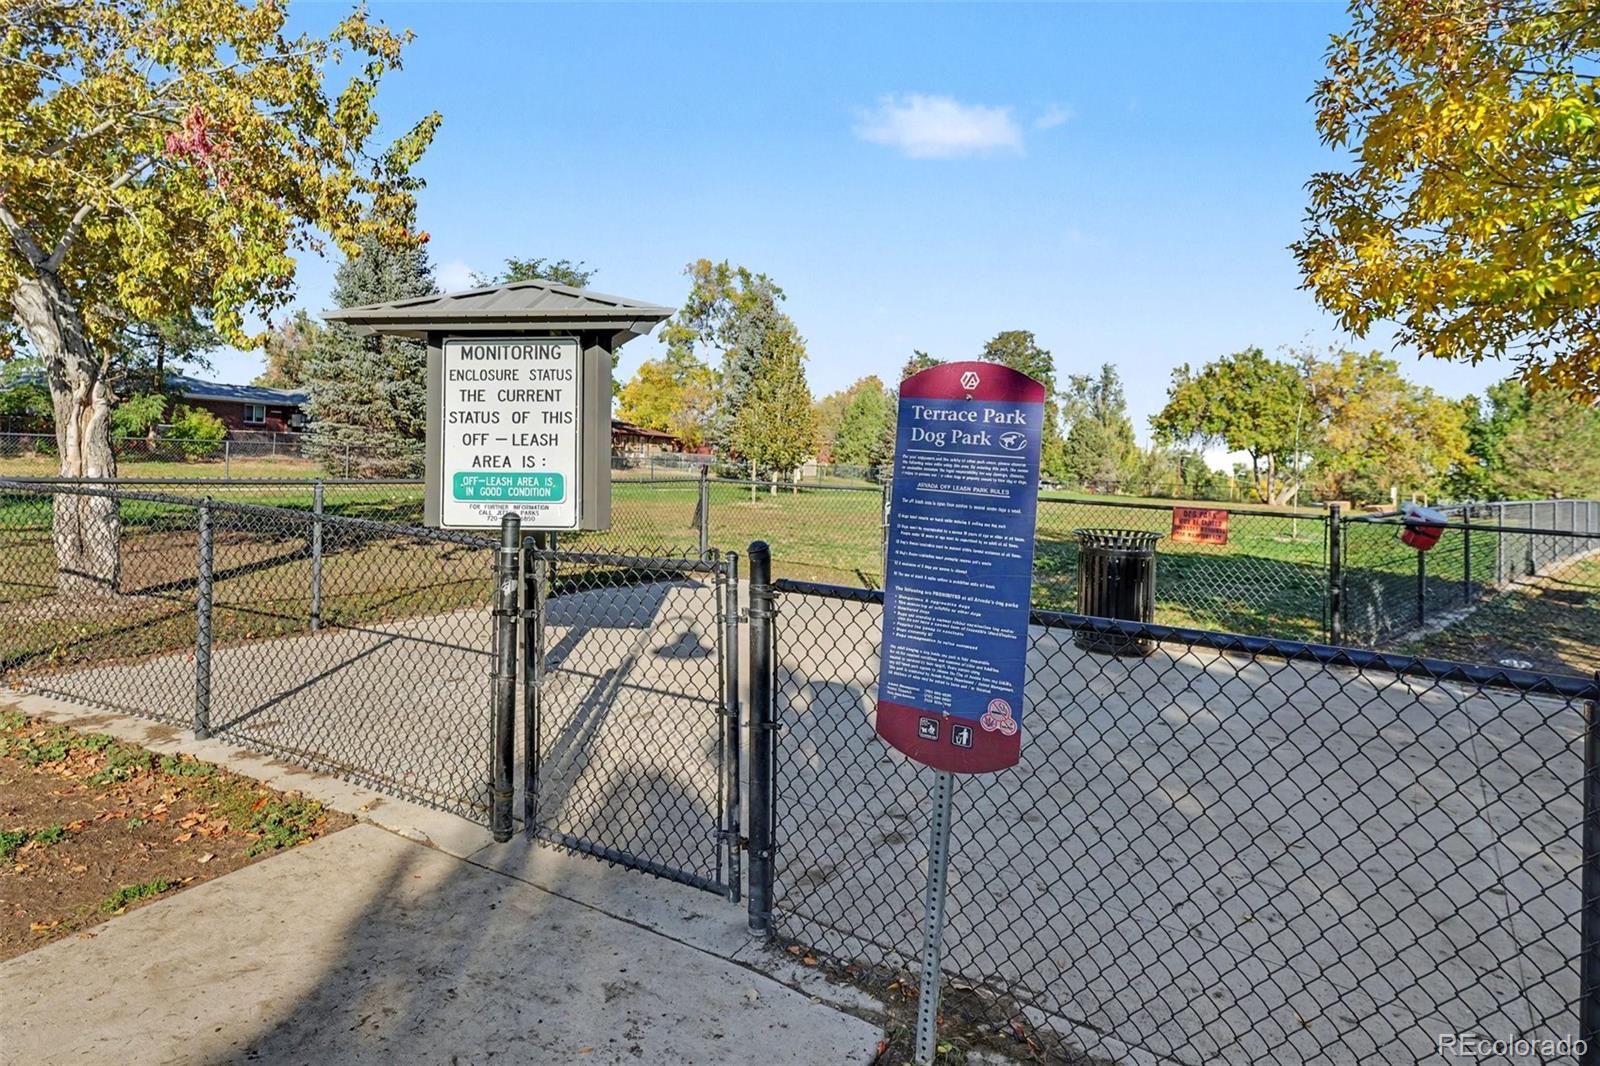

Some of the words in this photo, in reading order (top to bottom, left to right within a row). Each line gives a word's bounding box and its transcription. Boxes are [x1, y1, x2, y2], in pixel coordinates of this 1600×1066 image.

[461, 345, 561, 360] MONITORING
[450, 369, 519, 381] ENCLOSURE
[529, 369, 572, 381] STATUS
[460, 390, 485, 402] THE
[498, 389, 562, 402] CURRENT
[449, 411, 499, 424] STATUS
[512, 411, 530, 423] OF
[542, 411, 572, 424] THIS
[912, 405, 977, 422] Terrace
[984, 408, 1026, 425] Park
[912, 427, 946, 447] Dog
[952, 430, 991, 446] Park
[472, 456, 510, 468] AREA
[517, 476, 539, 486] AREA
[544, 476, 553, 486] IS
[466, 487, 474, 496] IN
[480, 487, 501, 496] GOOD
[508, 487, 550, 496] CONDITION
